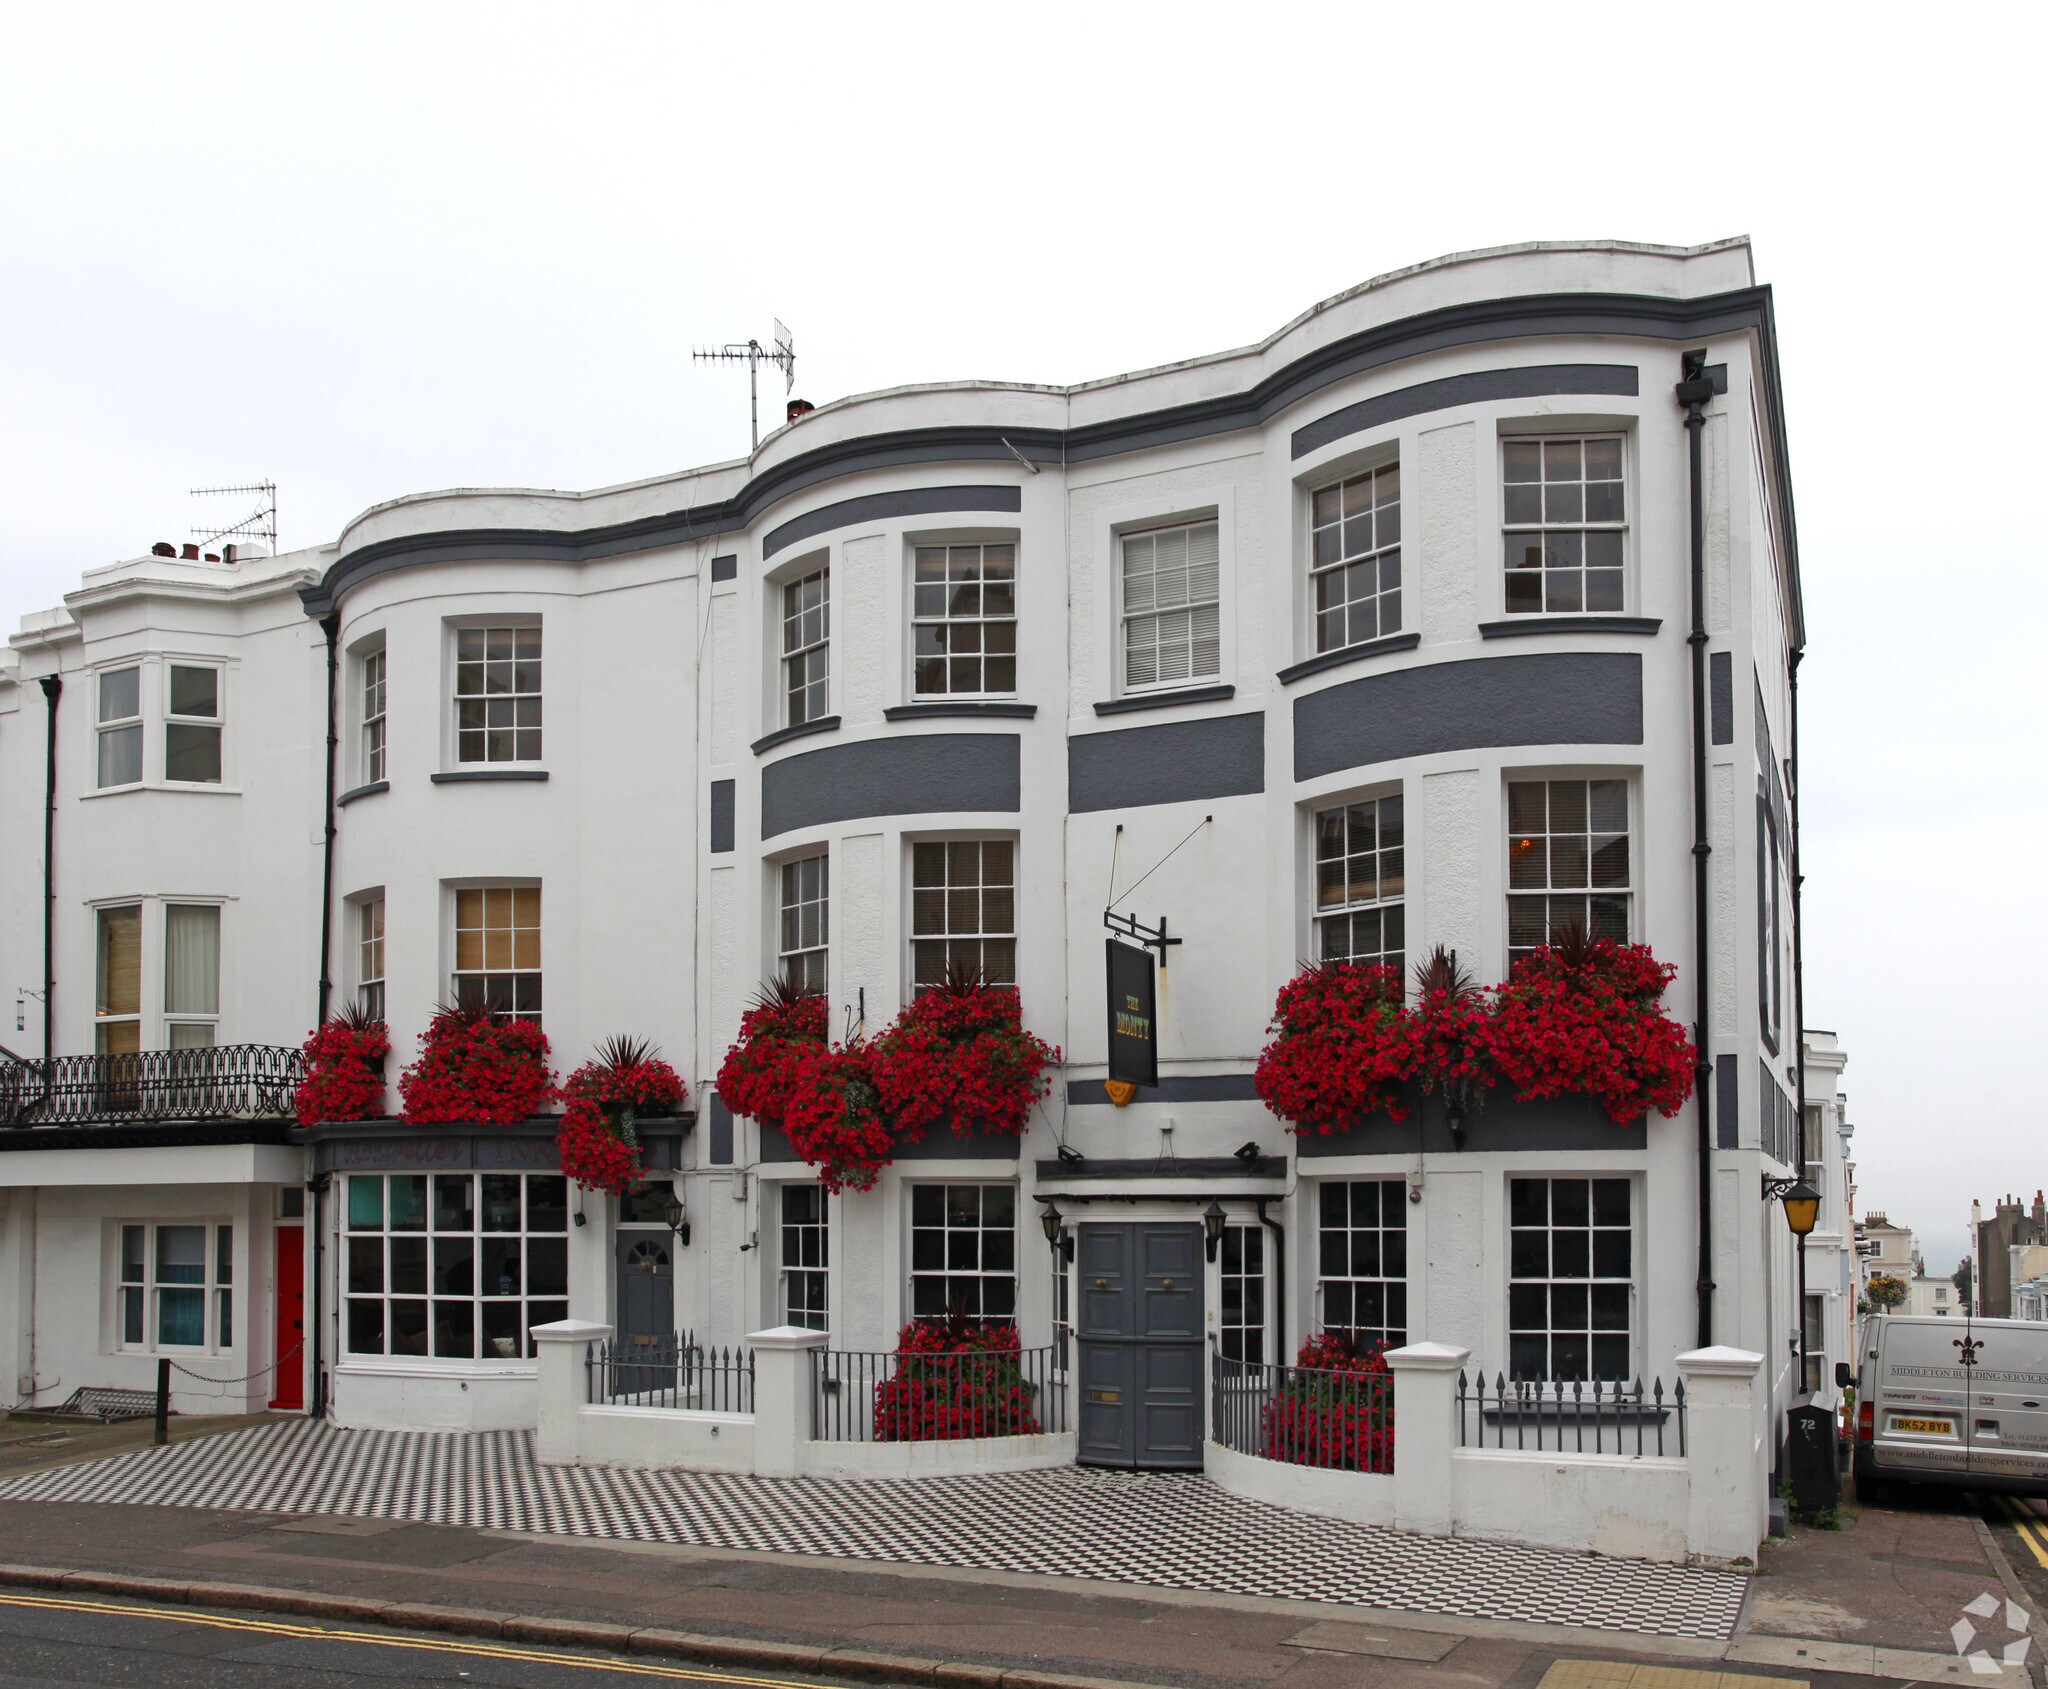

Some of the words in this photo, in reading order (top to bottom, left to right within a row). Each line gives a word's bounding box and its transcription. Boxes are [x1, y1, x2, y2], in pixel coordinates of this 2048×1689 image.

[1126, 995, 1139, 1011] THE
[1116, 1011, 1149, 1040] MONTY
[1891, 1366, 1950, 1377] MIDDLETON
[1952, 1369, 2000, 1380] BUILDING
[2002, 1373, 2048, 1383] SERVICES
[1883, 1392, 1916, 1400] TRANSIT
[1800, 1419, 1815, 1430] 72
[1898, 1420, 1926, 1431] BK52
[1929, 1422, 1950, 1432] BYB
